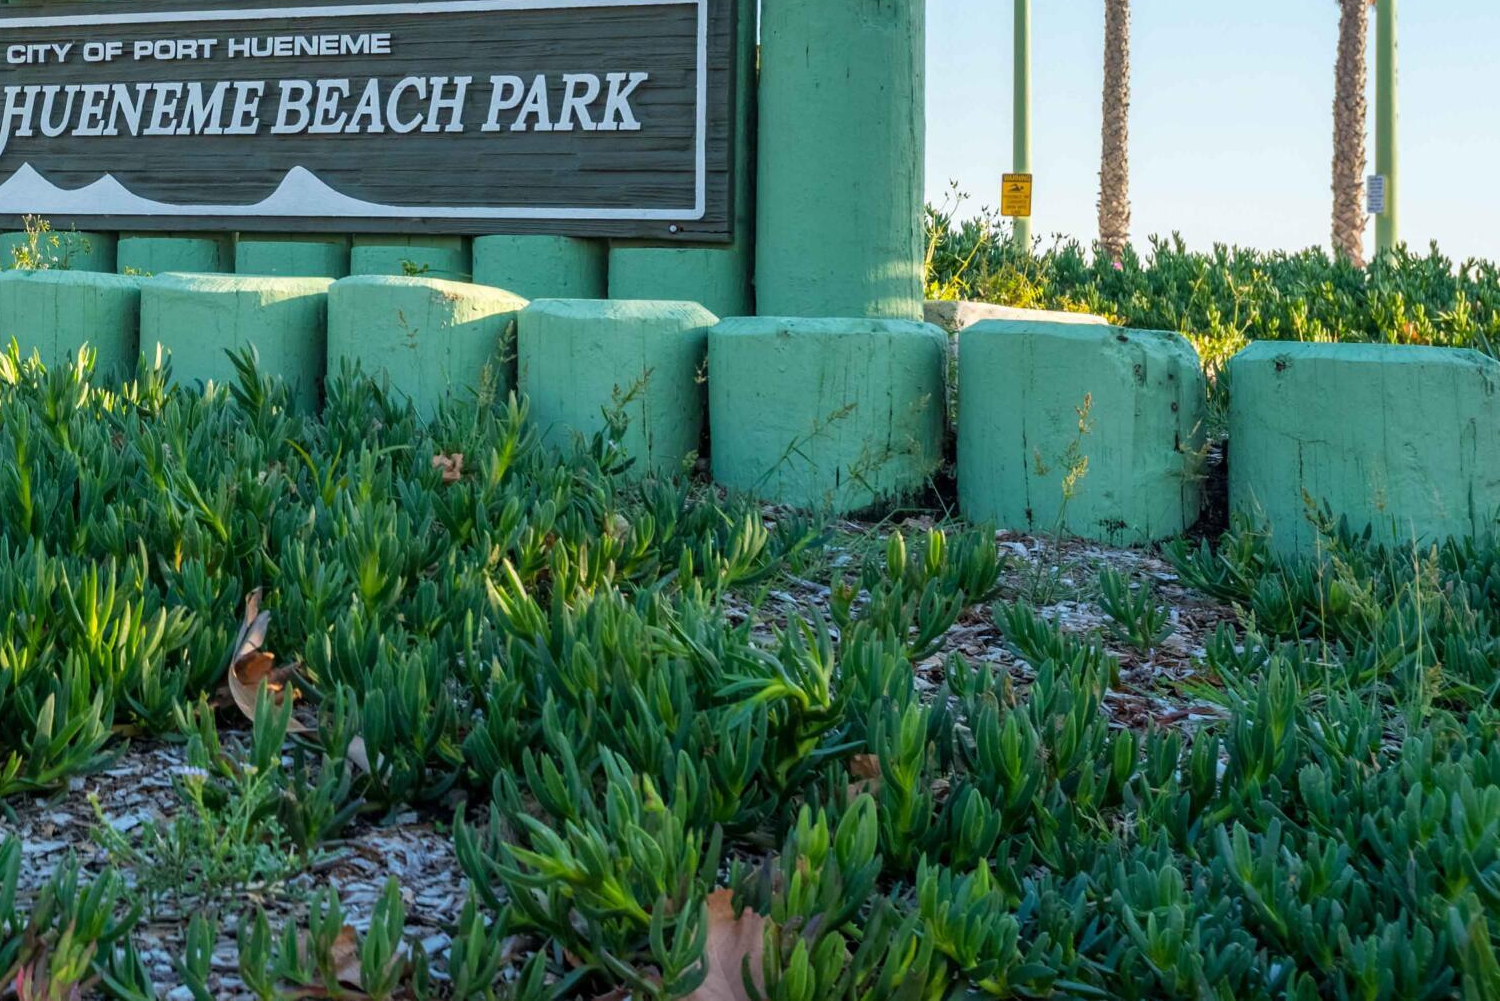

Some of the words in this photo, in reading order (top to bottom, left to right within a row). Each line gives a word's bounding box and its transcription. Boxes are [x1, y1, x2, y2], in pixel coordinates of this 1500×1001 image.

[5, 43, 74, 64] CITY
[83, 41, 123, 62] OF
[133, 39, 218, 61] PORT
[228, 33, 392, 58] HUENEME
[270, 75, 473, 134] BEACH
[481, 72, 649, 132] PARK
